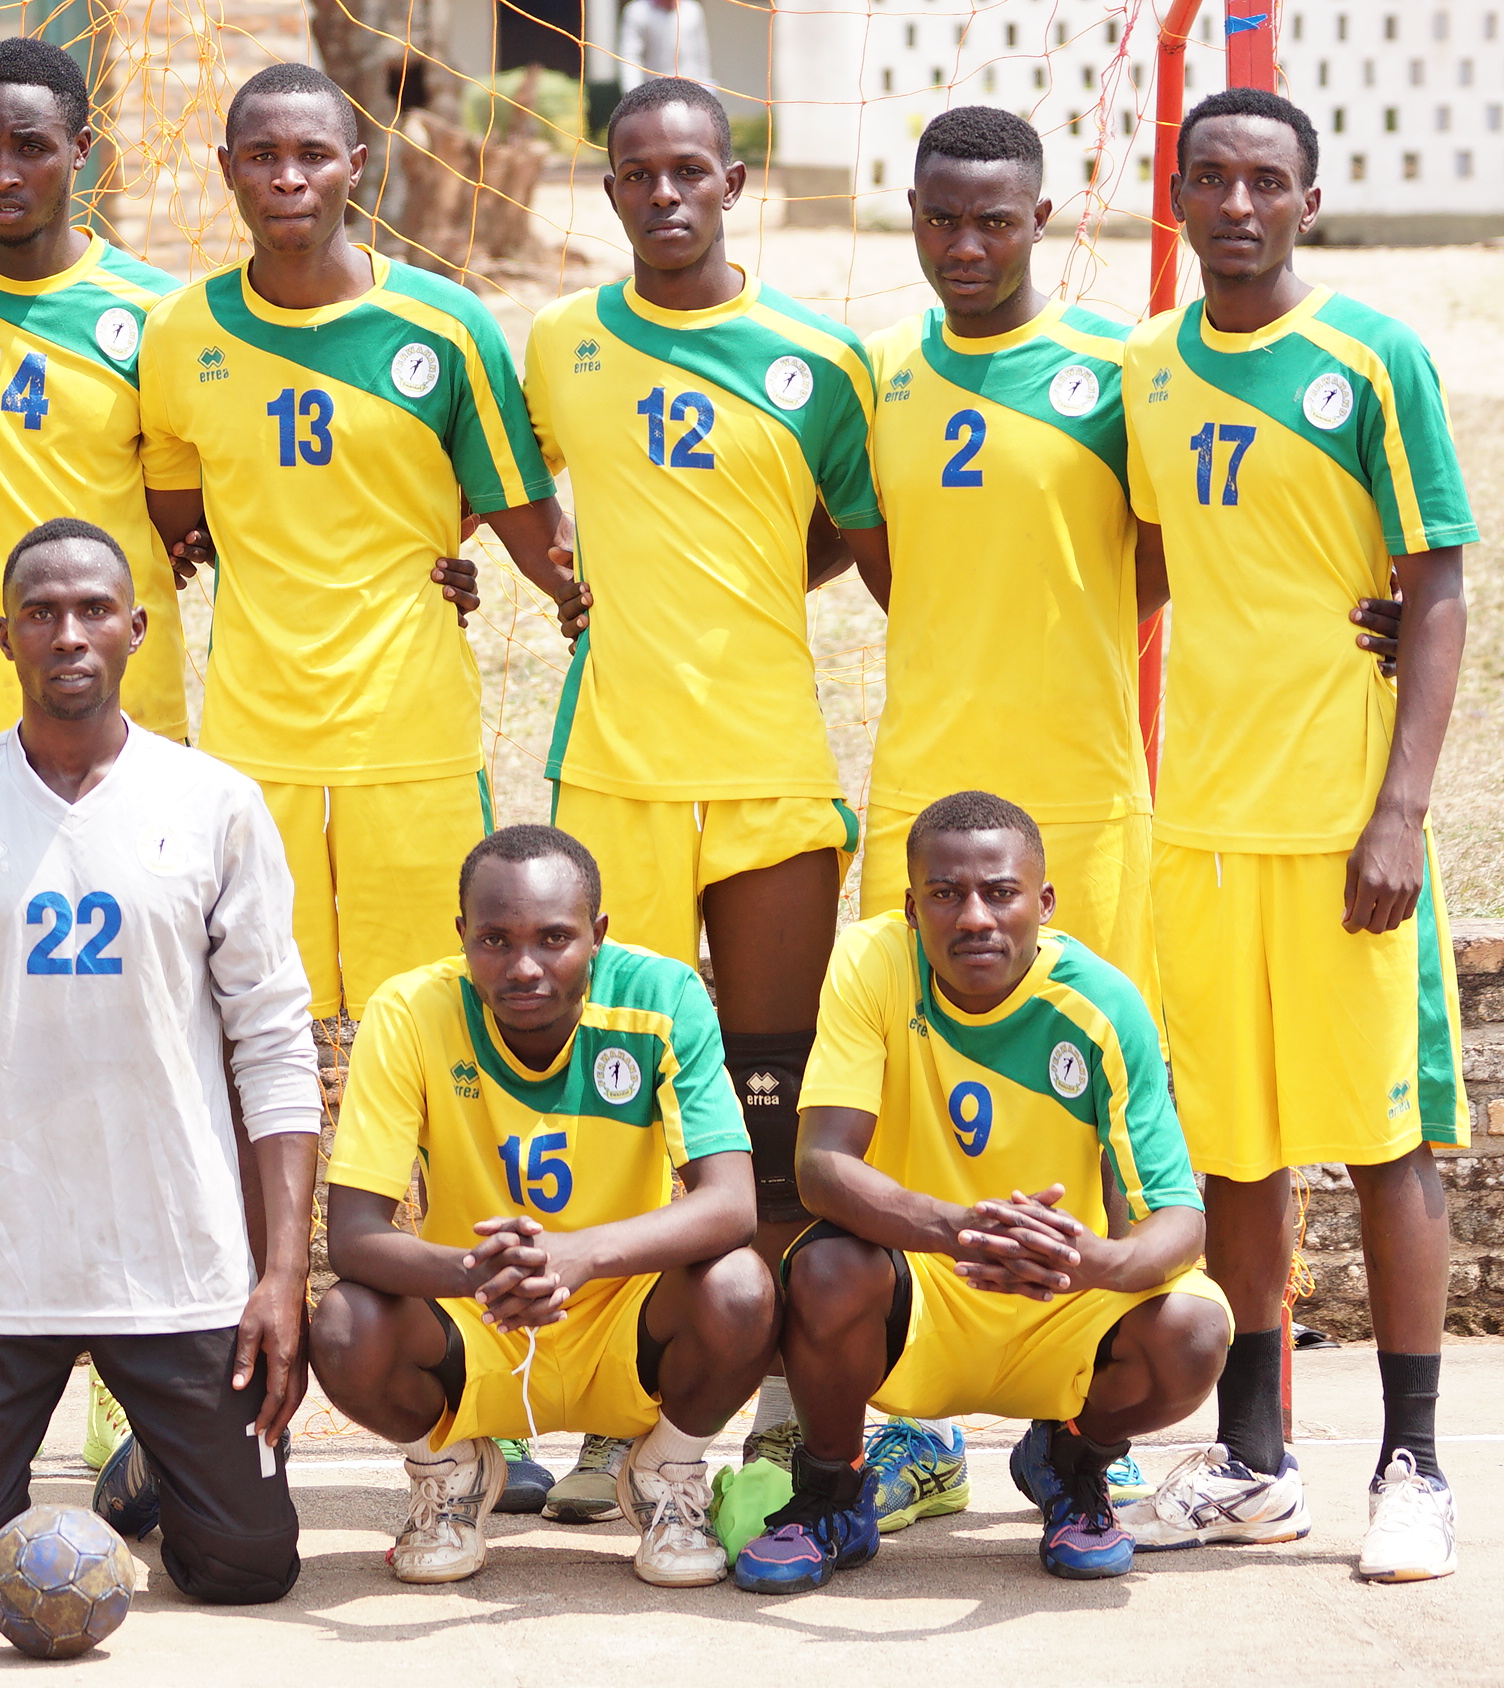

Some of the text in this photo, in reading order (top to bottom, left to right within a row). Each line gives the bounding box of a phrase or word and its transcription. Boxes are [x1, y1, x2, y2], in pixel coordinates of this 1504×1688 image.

[199, 368, 229, 382] errea
[574, 360, 601, 374] errea
[884, 390, 910, 402] errea
[1148, 390, 1169, 403] errea
[267, 388, 334, 466] 13
[637, 387, 714, 469] 12
[942, 409, 986, 487] 2
[1191, 422, 1256, 506] 17
[26, 891, 123, 975] 22
[453, 1084, 480, 1099] rrea
[746, 1094, 780, 1106] errea
[949, 1081, 993, 1156] 9
[499, 1132, 573, 1213] 15
